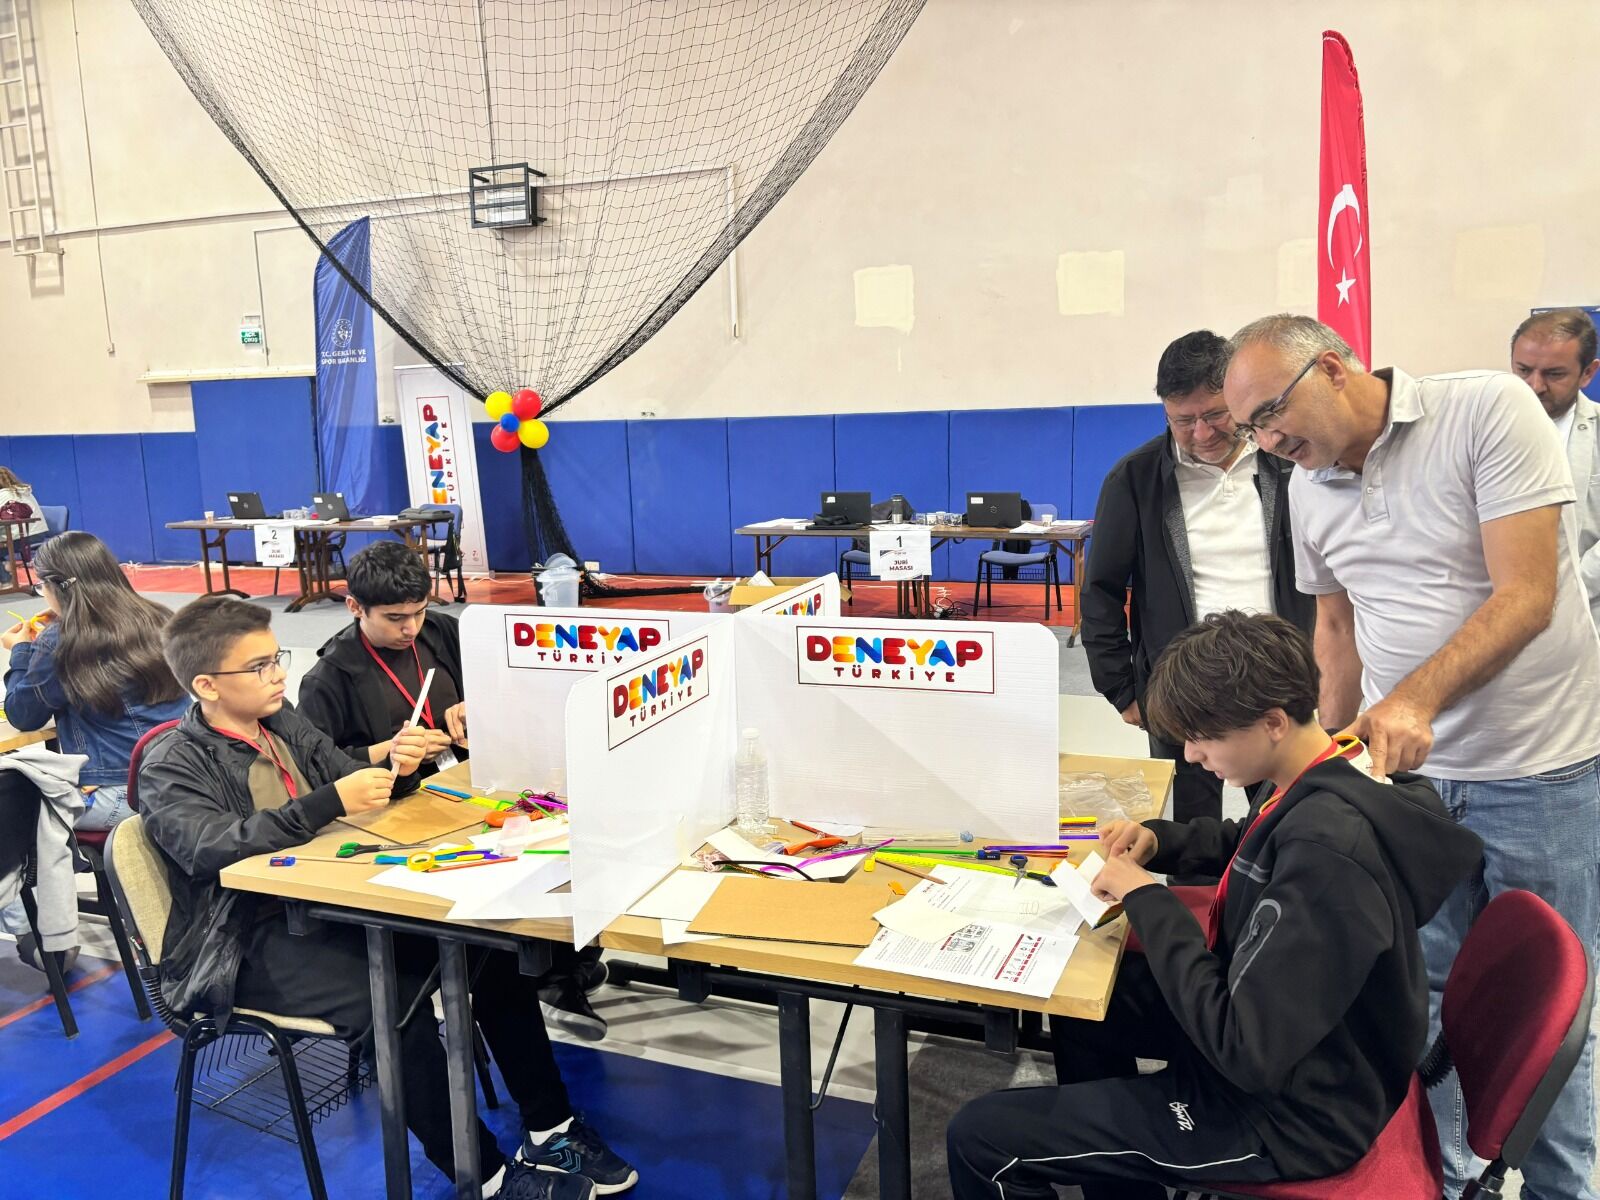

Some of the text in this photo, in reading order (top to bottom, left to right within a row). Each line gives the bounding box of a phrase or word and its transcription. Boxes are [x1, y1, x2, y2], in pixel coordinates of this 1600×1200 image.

[422, 404, 448, 505] ENEYAP
[441, 421, 456, 504] TÜRKİYE
[271, 529, 278, 540] 2
[896, 535, 903, 548] 1
[513, 622, 661, 652] DENEYAP
[806, 635, 983, 668] DENEYAP
[537, 649, 623, 664] TÜRKİY
[613, 648, 704, 719] DENEYAP
[833, 664, 956, 683] TÜRKİYE
[629, 685, 692, 728] TÜRKİYE
